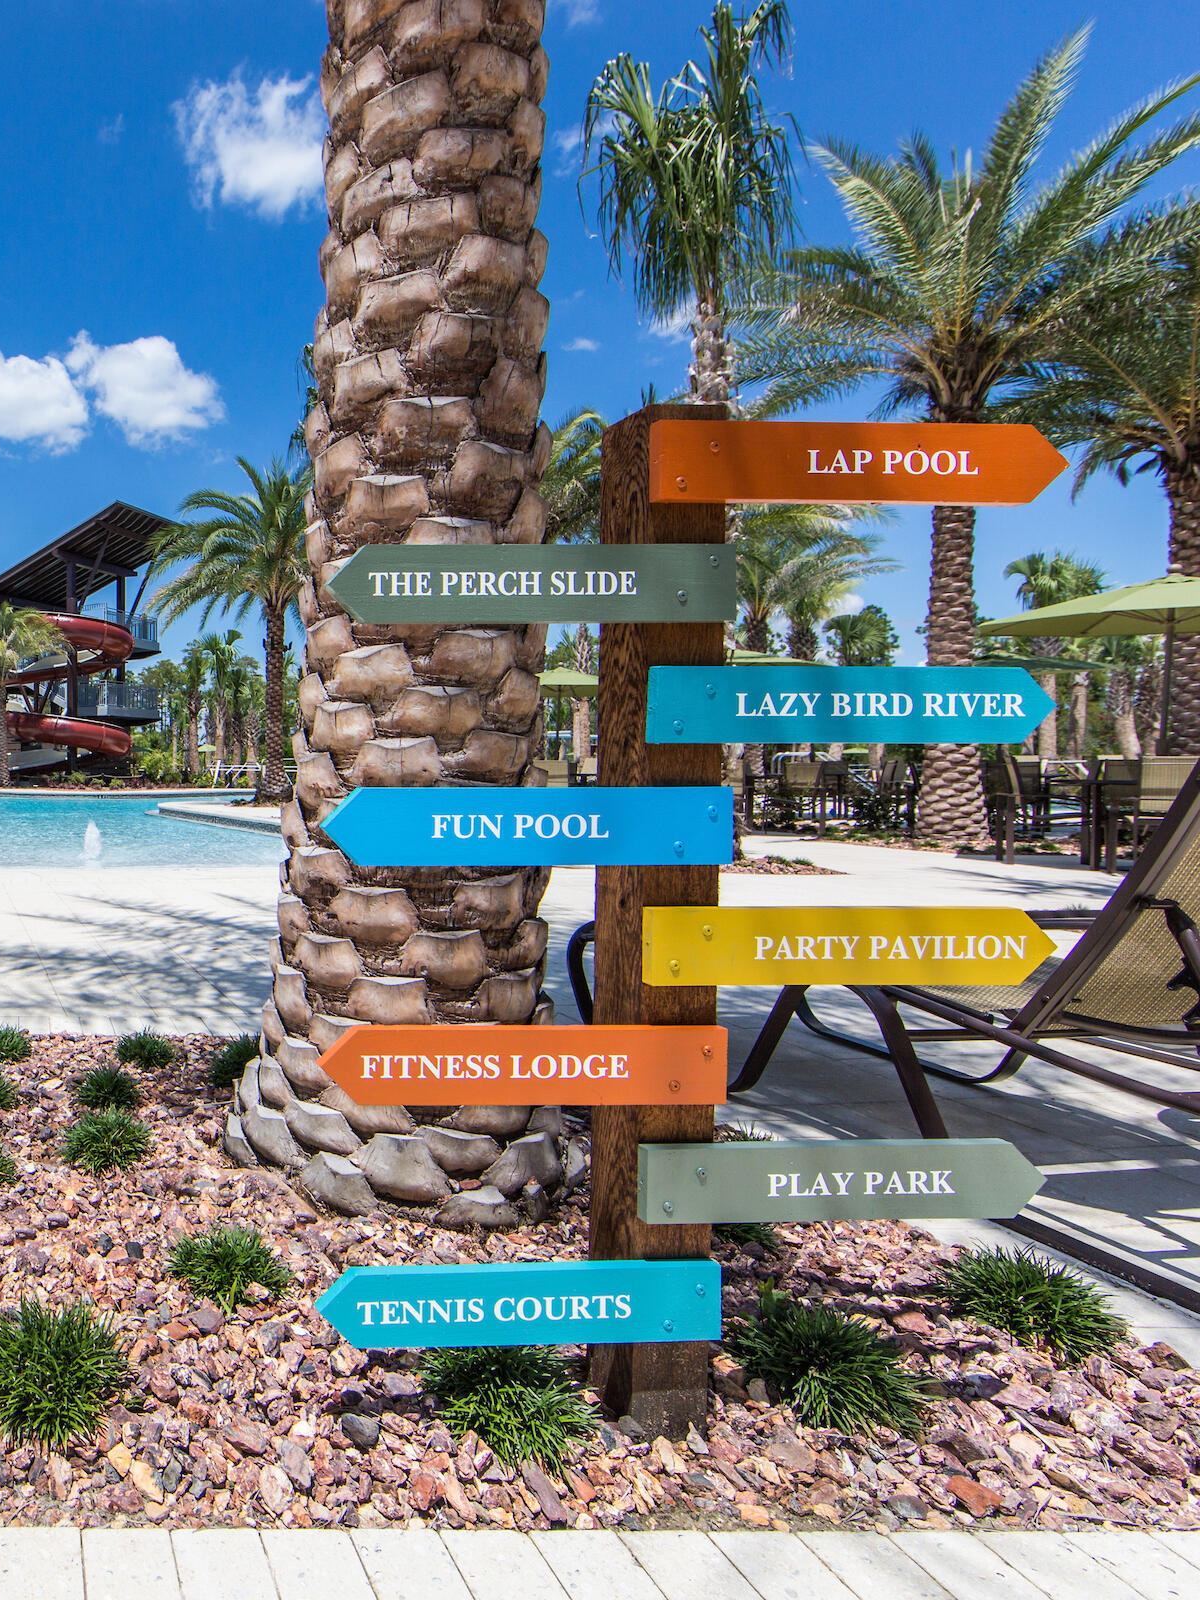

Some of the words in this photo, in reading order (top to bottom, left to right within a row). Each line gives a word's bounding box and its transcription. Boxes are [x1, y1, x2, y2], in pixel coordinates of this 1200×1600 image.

[808, 450, 872, 474] LAP
[883, 450, 979, 475] POOL
[369, 571, 432, 597] THE
[440, 571, 542, 596] PERCH
[550, 571, 637, 596] SLIDE
[735, 693, 821, 717] LAZY
[831, 693, 913, 717] BIRD
[922, 693, 1026, 717] RIVER
[431, 814, 503, 839] FUN
[513, 814, 609, 839] POOL
[754, 936, 860, 960] PARTY
[869, 935, 1027, 960] PAVILION
[361, 1055, 500, 1079] FITNESS
[510, 1054, 629, 1079] LODGE
[767, 1172, 855, 1197] PLAY
[863, 1170, 956, 1195] PARK
[356, 1298, 484, 1325] TENNIS
[493, 1294, 632, 1322] COURTS
